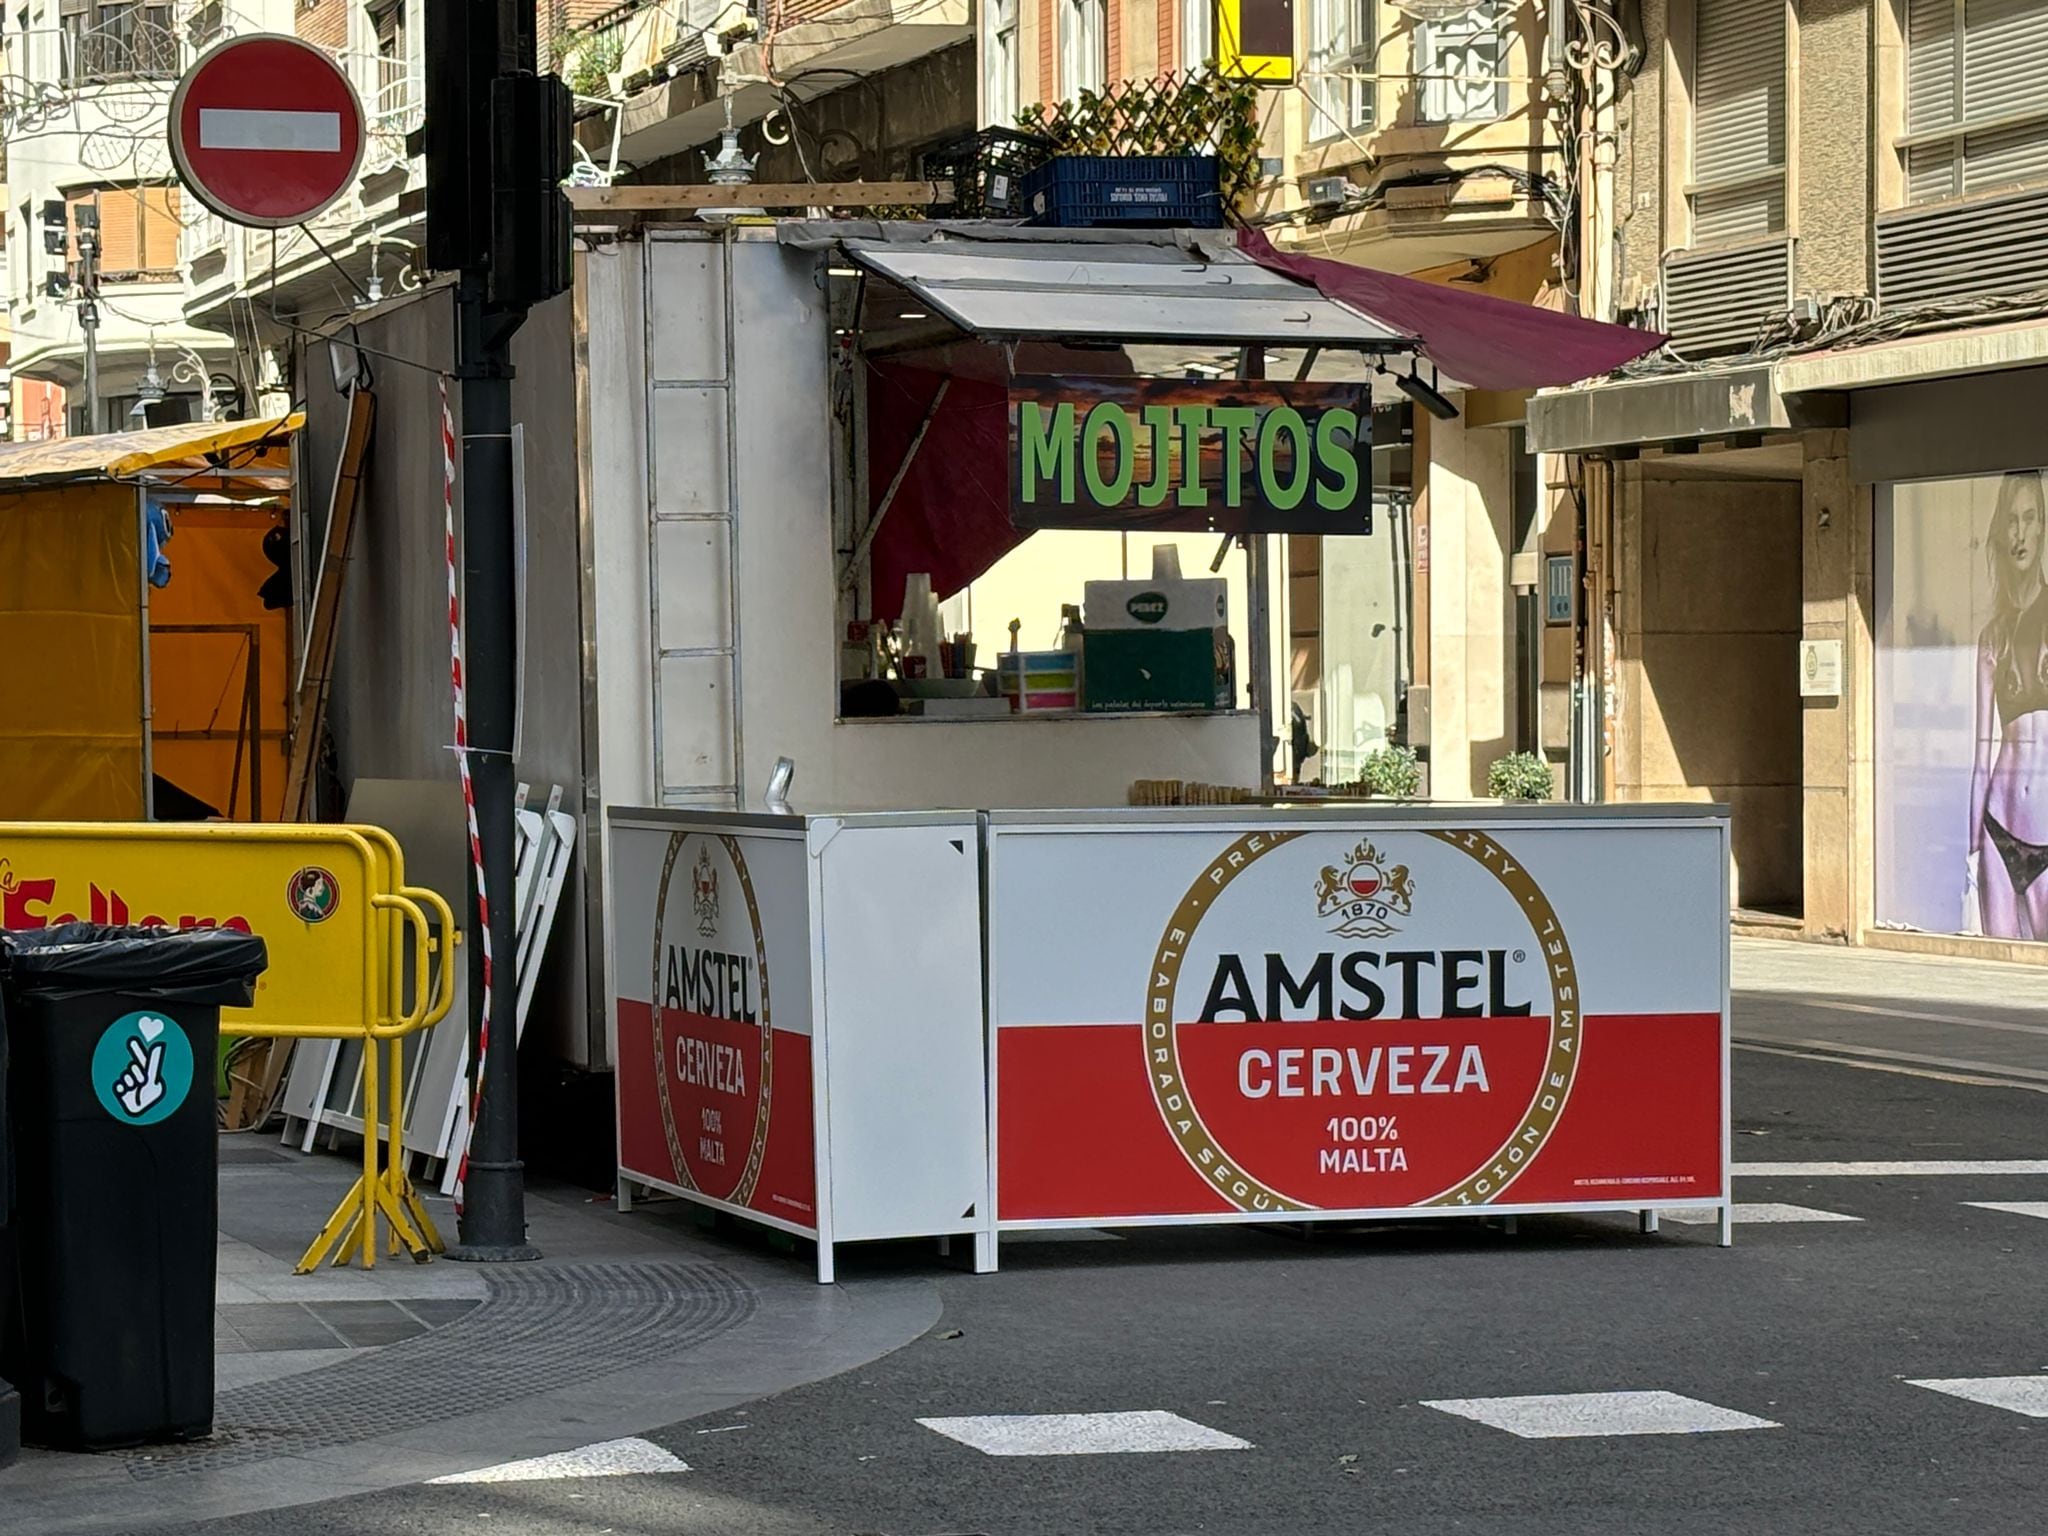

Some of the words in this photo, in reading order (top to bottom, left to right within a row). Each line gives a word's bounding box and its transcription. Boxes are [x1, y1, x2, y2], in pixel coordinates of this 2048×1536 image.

[1020, 401, 1360, 511] MOJITOS
[1341, 903, 1388, 920] 1870
[666, 944, 756, 1025] AMSTEL
[1543, 919, 1574, 1053] AMSTEL
[1152, 928, 1193, 1135] ELABORADA
[676, 1035, 746, 1098] CERVEZA
[1238, 1045, 1491, 1099] CERVEZA
[1541, 1072, 1565, 1112] DE
[701, 1107, 722, 1135] 100%
[1326, 1116, 1399, 1142] 100%
[699, 1136, 725, 1166] MALTA
[1319, 1147, 1409, 1175] MALTA
[1441, 1126, 1540, 1206] ICIÓN
